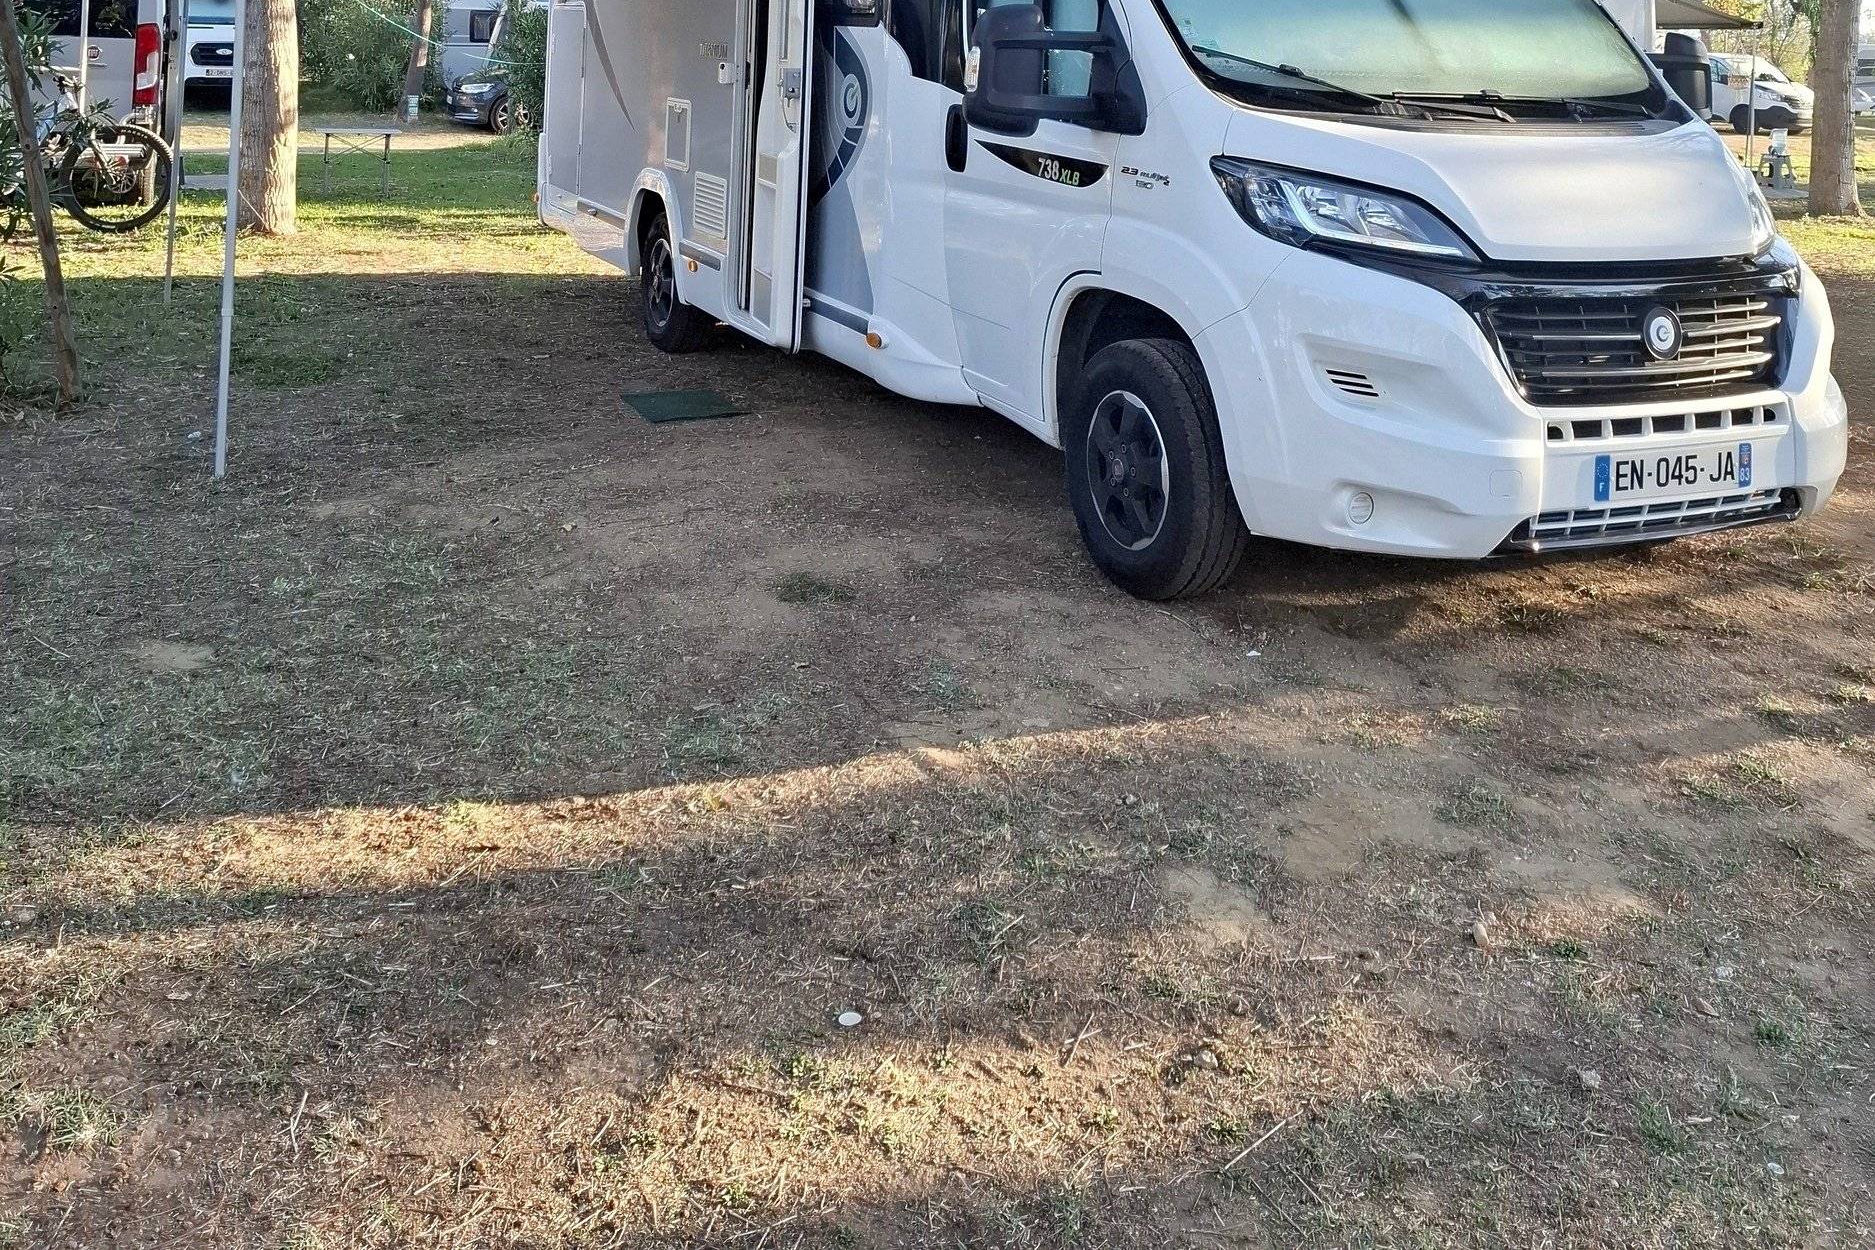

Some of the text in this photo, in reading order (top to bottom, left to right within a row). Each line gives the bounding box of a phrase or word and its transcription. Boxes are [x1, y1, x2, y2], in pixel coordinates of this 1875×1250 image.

[1038, 157, 1080, 186] 738 XLB
[1598, 482, 1605, 493] F
[1740, 467, 1750, 482] 83
